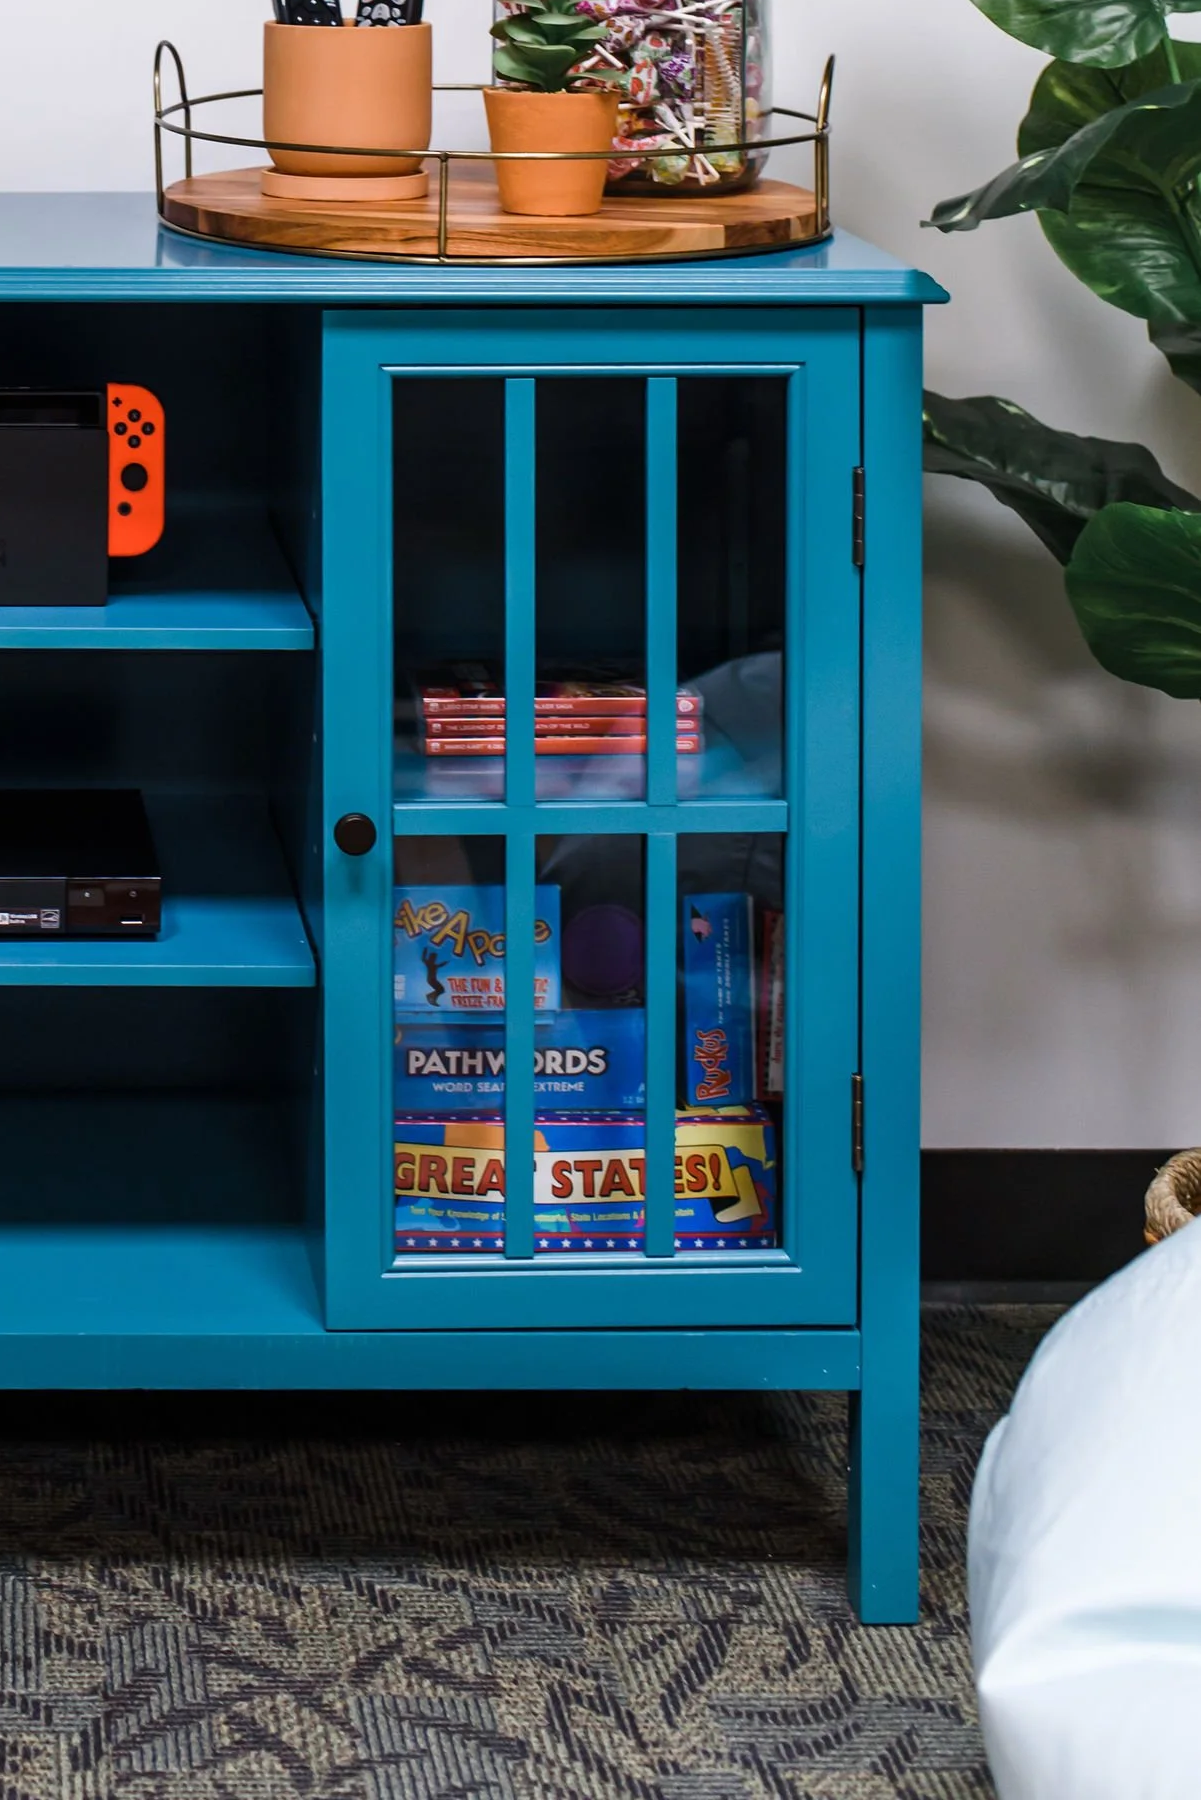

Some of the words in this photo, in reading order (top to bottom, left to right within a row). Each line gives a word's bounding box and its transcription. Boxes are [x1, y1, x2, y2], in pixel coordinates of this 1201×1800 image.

[447, 977, 468, 993] THE
[471, 977, 491, 993] FUN
[494, 977, 503, 992] &
[433, 1082, 473, 1093] WORD
[395, 1152, 536, 1197] GREA
